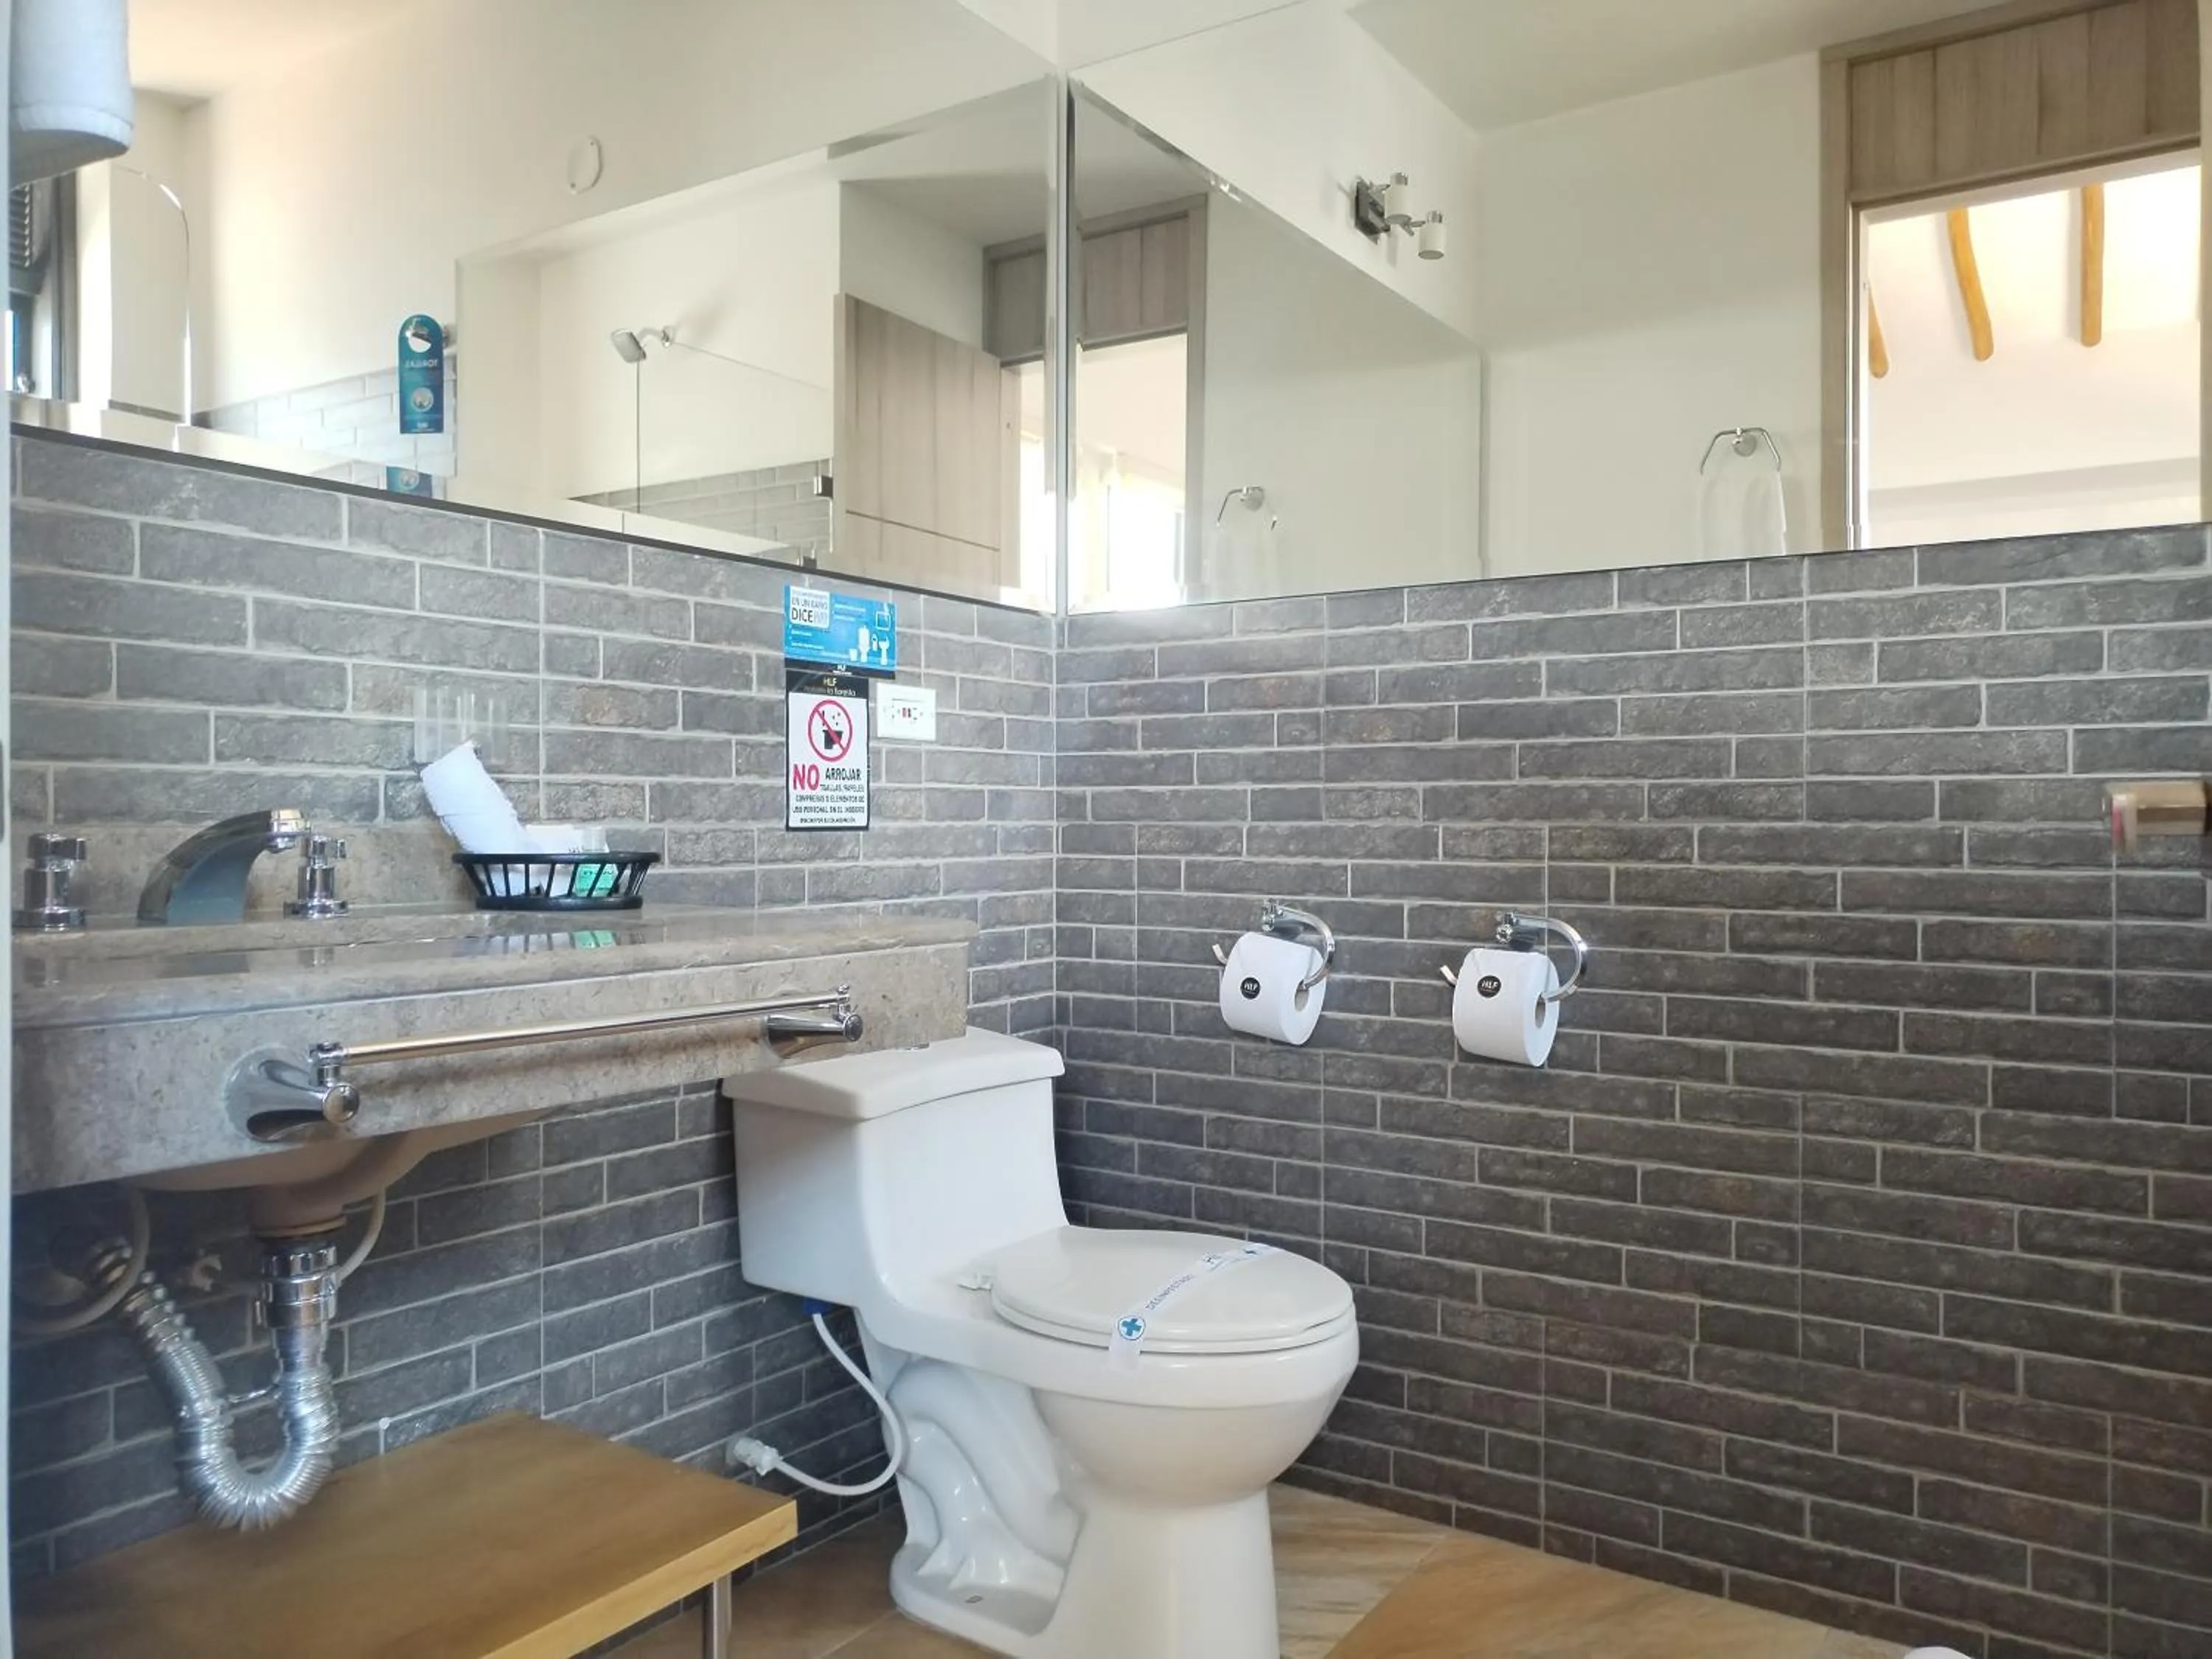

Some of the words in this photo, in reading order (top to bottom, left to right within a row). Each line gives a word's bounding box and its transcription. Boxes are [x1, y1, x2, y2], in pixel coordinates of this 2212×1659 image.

[791, 607, 813, 623] DICE
[823, 677, 838, 686] HLF
[793, 764, 821, 791] NO
[825, 768, 861, 781] ARROJAR
